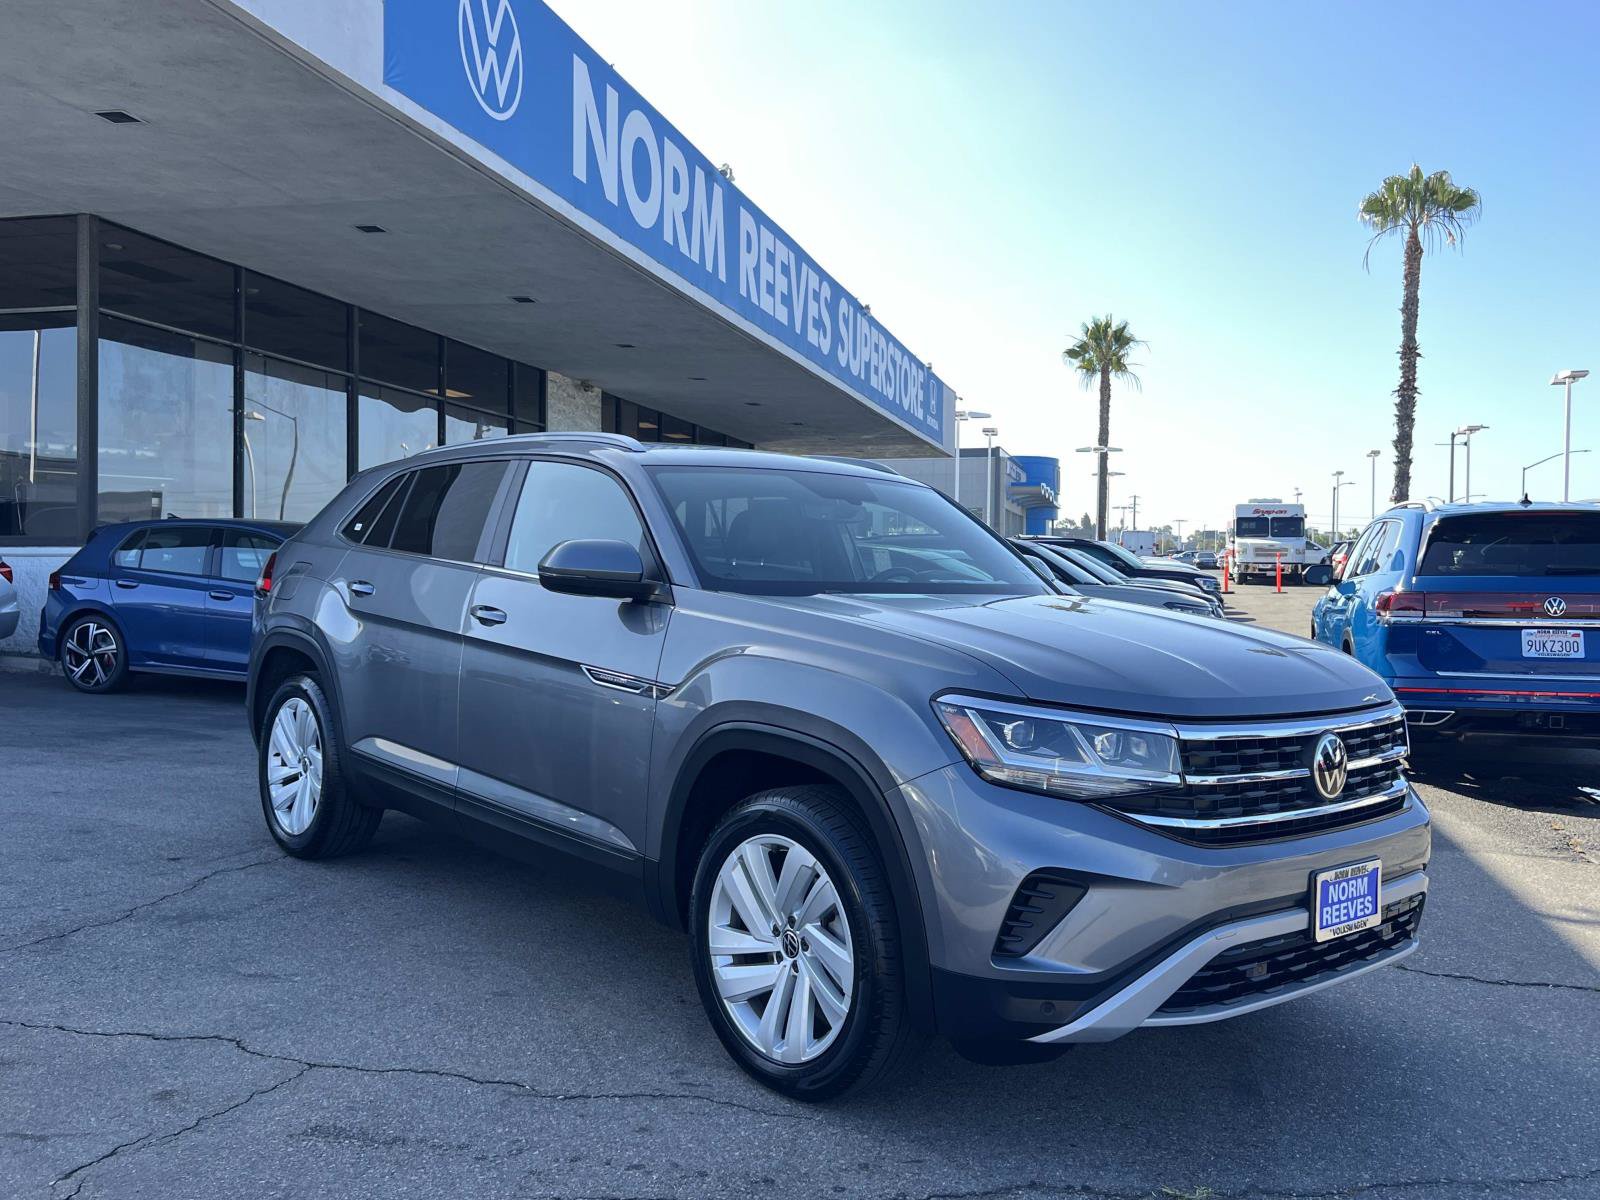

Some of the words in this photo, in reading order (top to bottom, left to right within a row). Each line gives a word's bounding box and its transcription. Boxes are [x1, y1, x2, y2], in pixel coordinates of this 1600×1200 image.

[572, 53, 726, 284] NORM
[739, 205, 831, 356] REEVES
[837, 296, 925, 421] SUPERSTORE
[1527, 639, 1580, 653] 9UKZ300
[1328, 876, 1369, 904] NORM
[1322, 895, 1373, 928] REEVES
